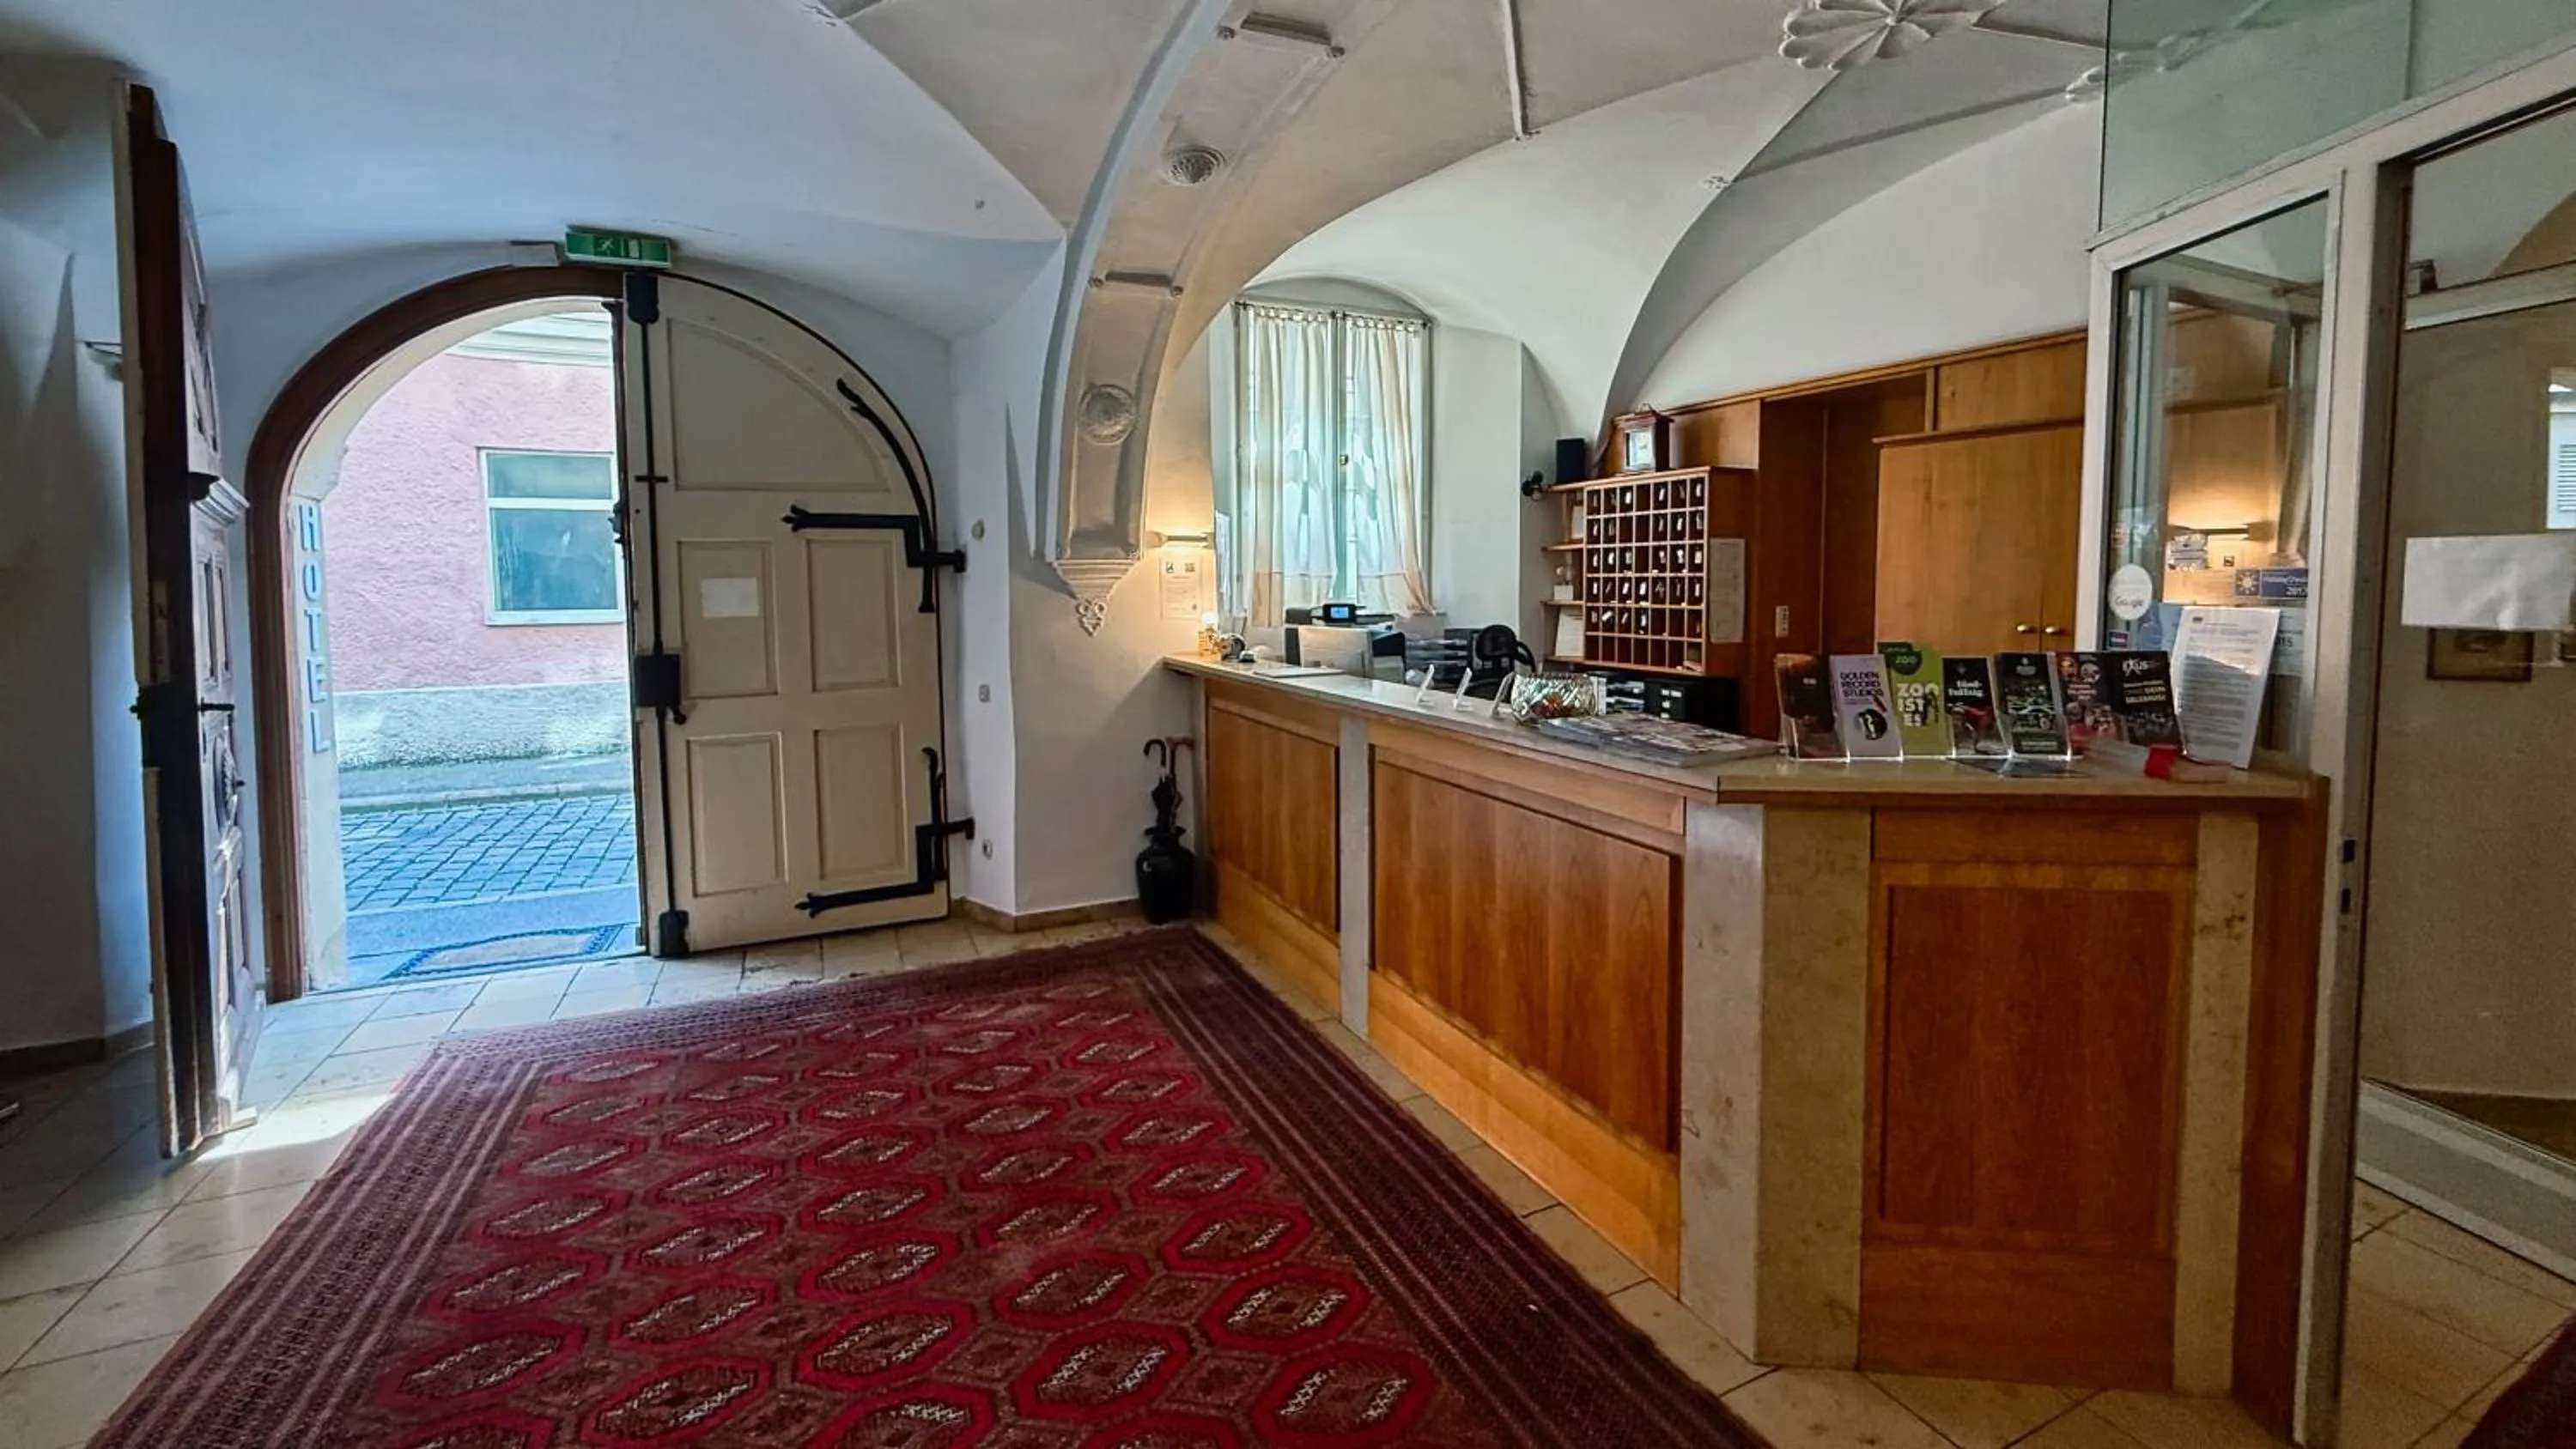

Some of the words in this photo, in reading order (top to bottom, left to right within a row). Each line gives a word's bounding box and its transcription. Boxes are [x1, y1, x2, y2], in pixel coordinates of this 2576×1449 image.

[299, 505, 331, 754] HOTEL
[1840, 671, 1880, 681] GOLDEN
[1841, 680, 1881, 688] RECORD
[1842, 688, 1884, 697] STUDIOS
[1897, 698, 1926, 712] IST
